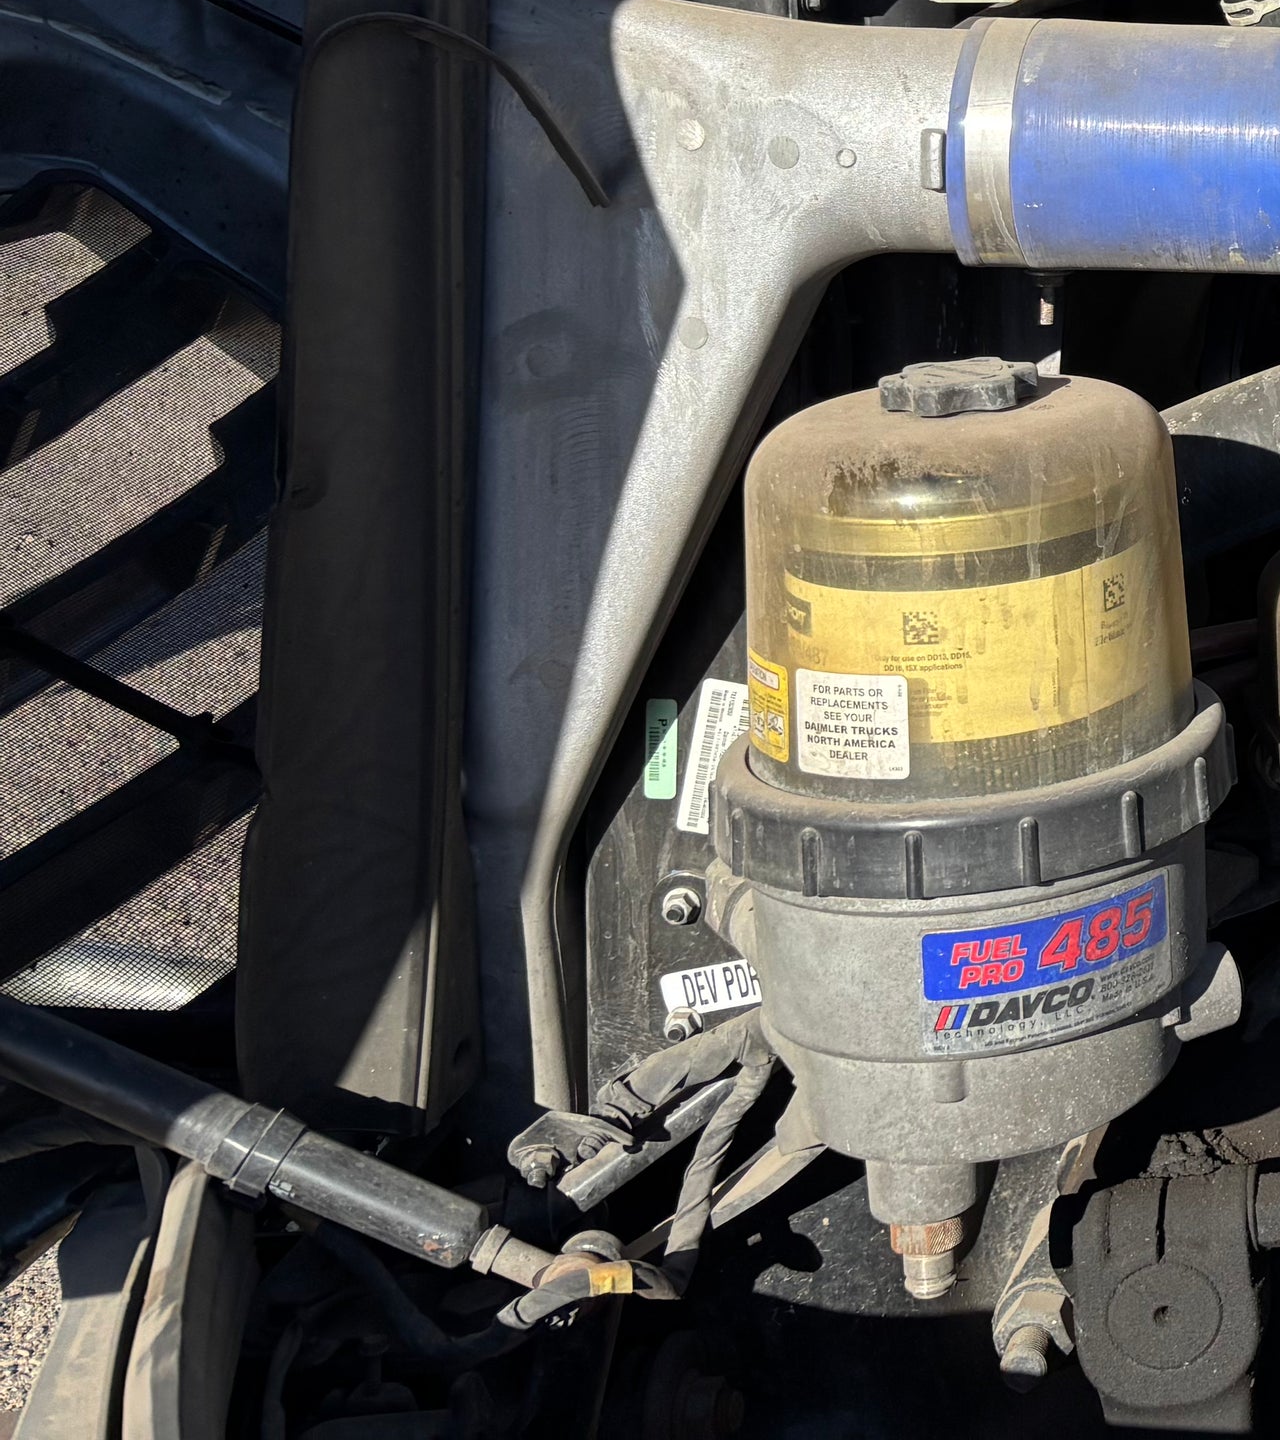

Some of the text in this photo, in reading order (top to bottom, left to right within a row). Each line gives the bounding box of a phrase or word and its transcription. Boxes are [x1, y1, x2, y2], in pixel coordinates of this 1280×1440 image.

[920, 663, 963, 672] applications
[813, 684, 883, 697] FOR PARTS OR
[810, 696, 889, 710] REPLACEMENTS
[824, 711, 873, 722] SEE YOUR
[804, 721, 899, 736] DAIMLER TRUCKS
[807, 734, 896, 748] NORTH AMERICA
[829, 749, 869, 761] DEALER
[1037, 889, 1154, 973] 485
[950, 934, 1027, 965] FUEL
[959, 958, 1025, 990] PRO
[681, 968, 718, 1008] DEV
[968, 978, 1095, 1029] DAVCO
[935, 1018, 1044, 1041] Technology,
